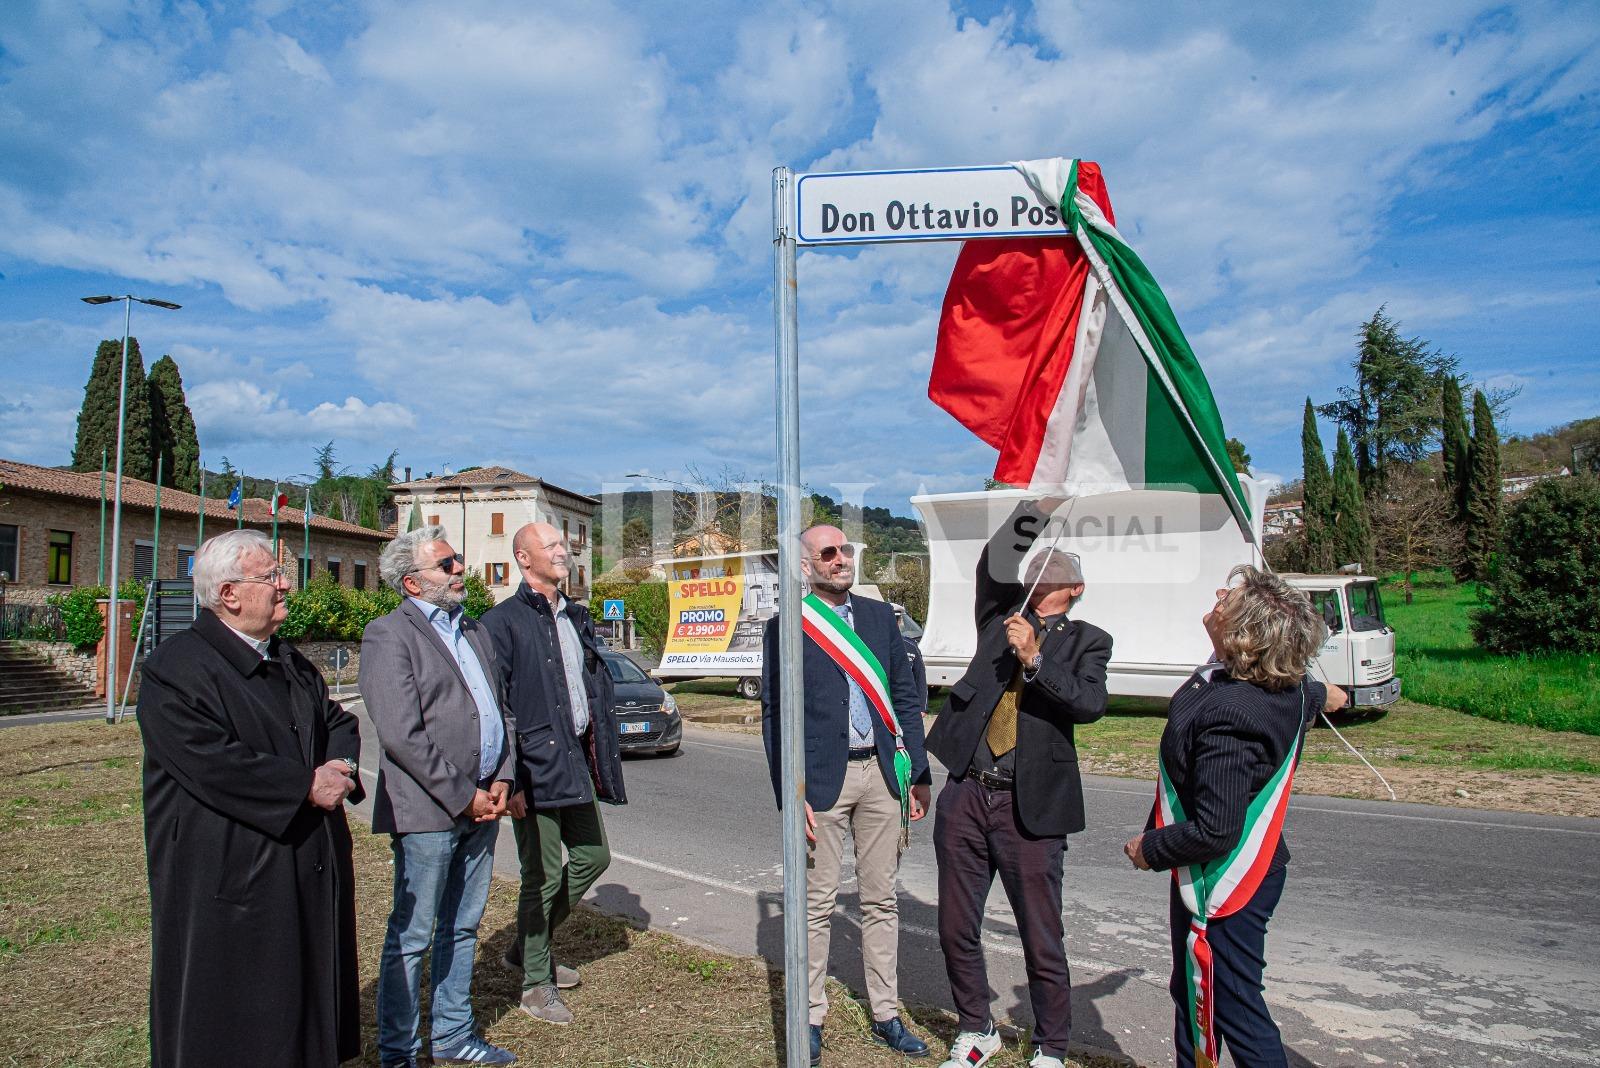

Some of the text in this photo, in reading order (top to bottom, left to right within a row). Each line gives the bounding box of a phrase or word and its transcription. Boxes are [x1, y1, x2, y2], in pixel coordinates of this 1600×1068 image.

[821, 203, 875, 234] Don
[885, 199, 999, 230] Ottavio
[681, 580, 737, 599] SPELLO
[681, 610, 724, 623] PROMO
[666, 655, 698, 664] SPELLO
[699, 654, 712, 663] Via
